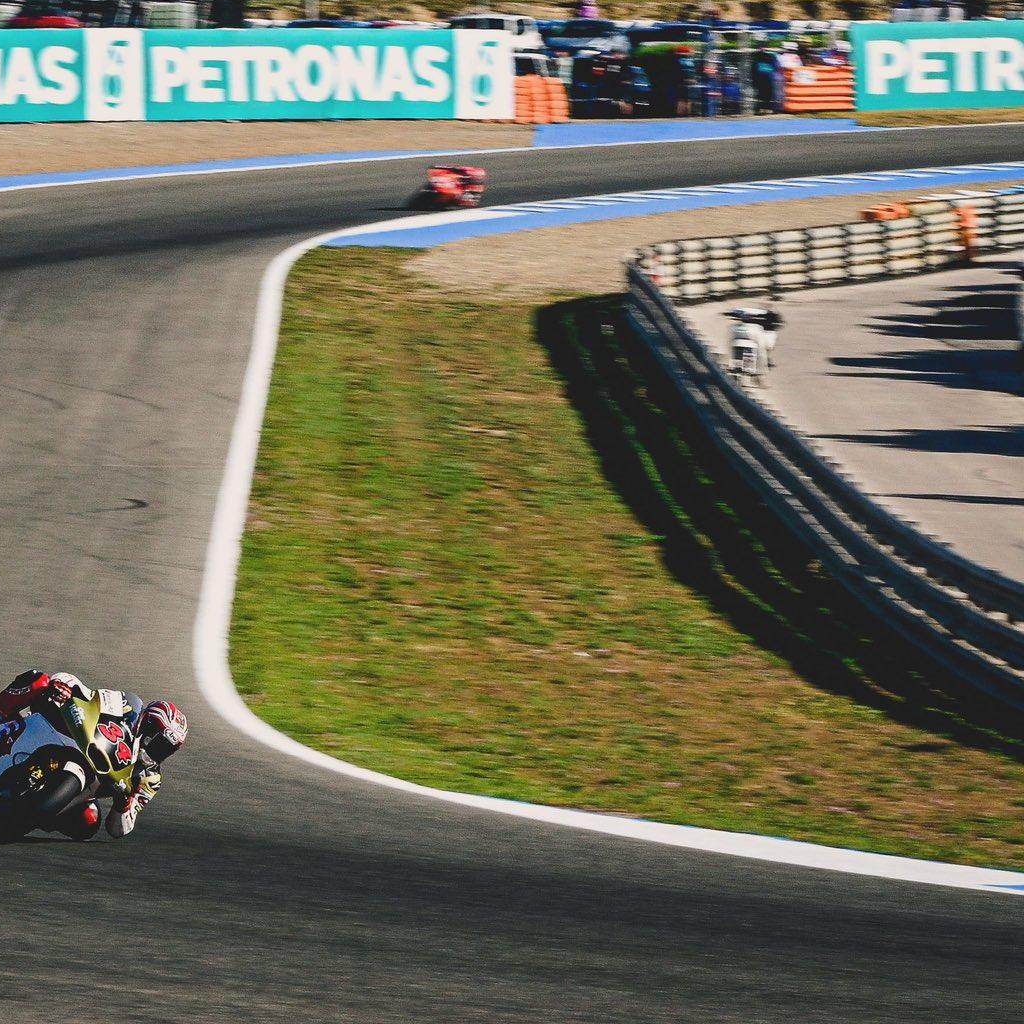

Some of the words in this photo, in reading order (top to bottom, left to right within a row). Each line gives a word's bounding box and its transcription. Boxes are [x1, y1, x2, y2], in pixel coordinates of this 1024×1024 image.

[150, 43, 451, 105] PETRONAS
[865, 37, 1024, 95] PETR
[96, 721, 132, 766] 34
